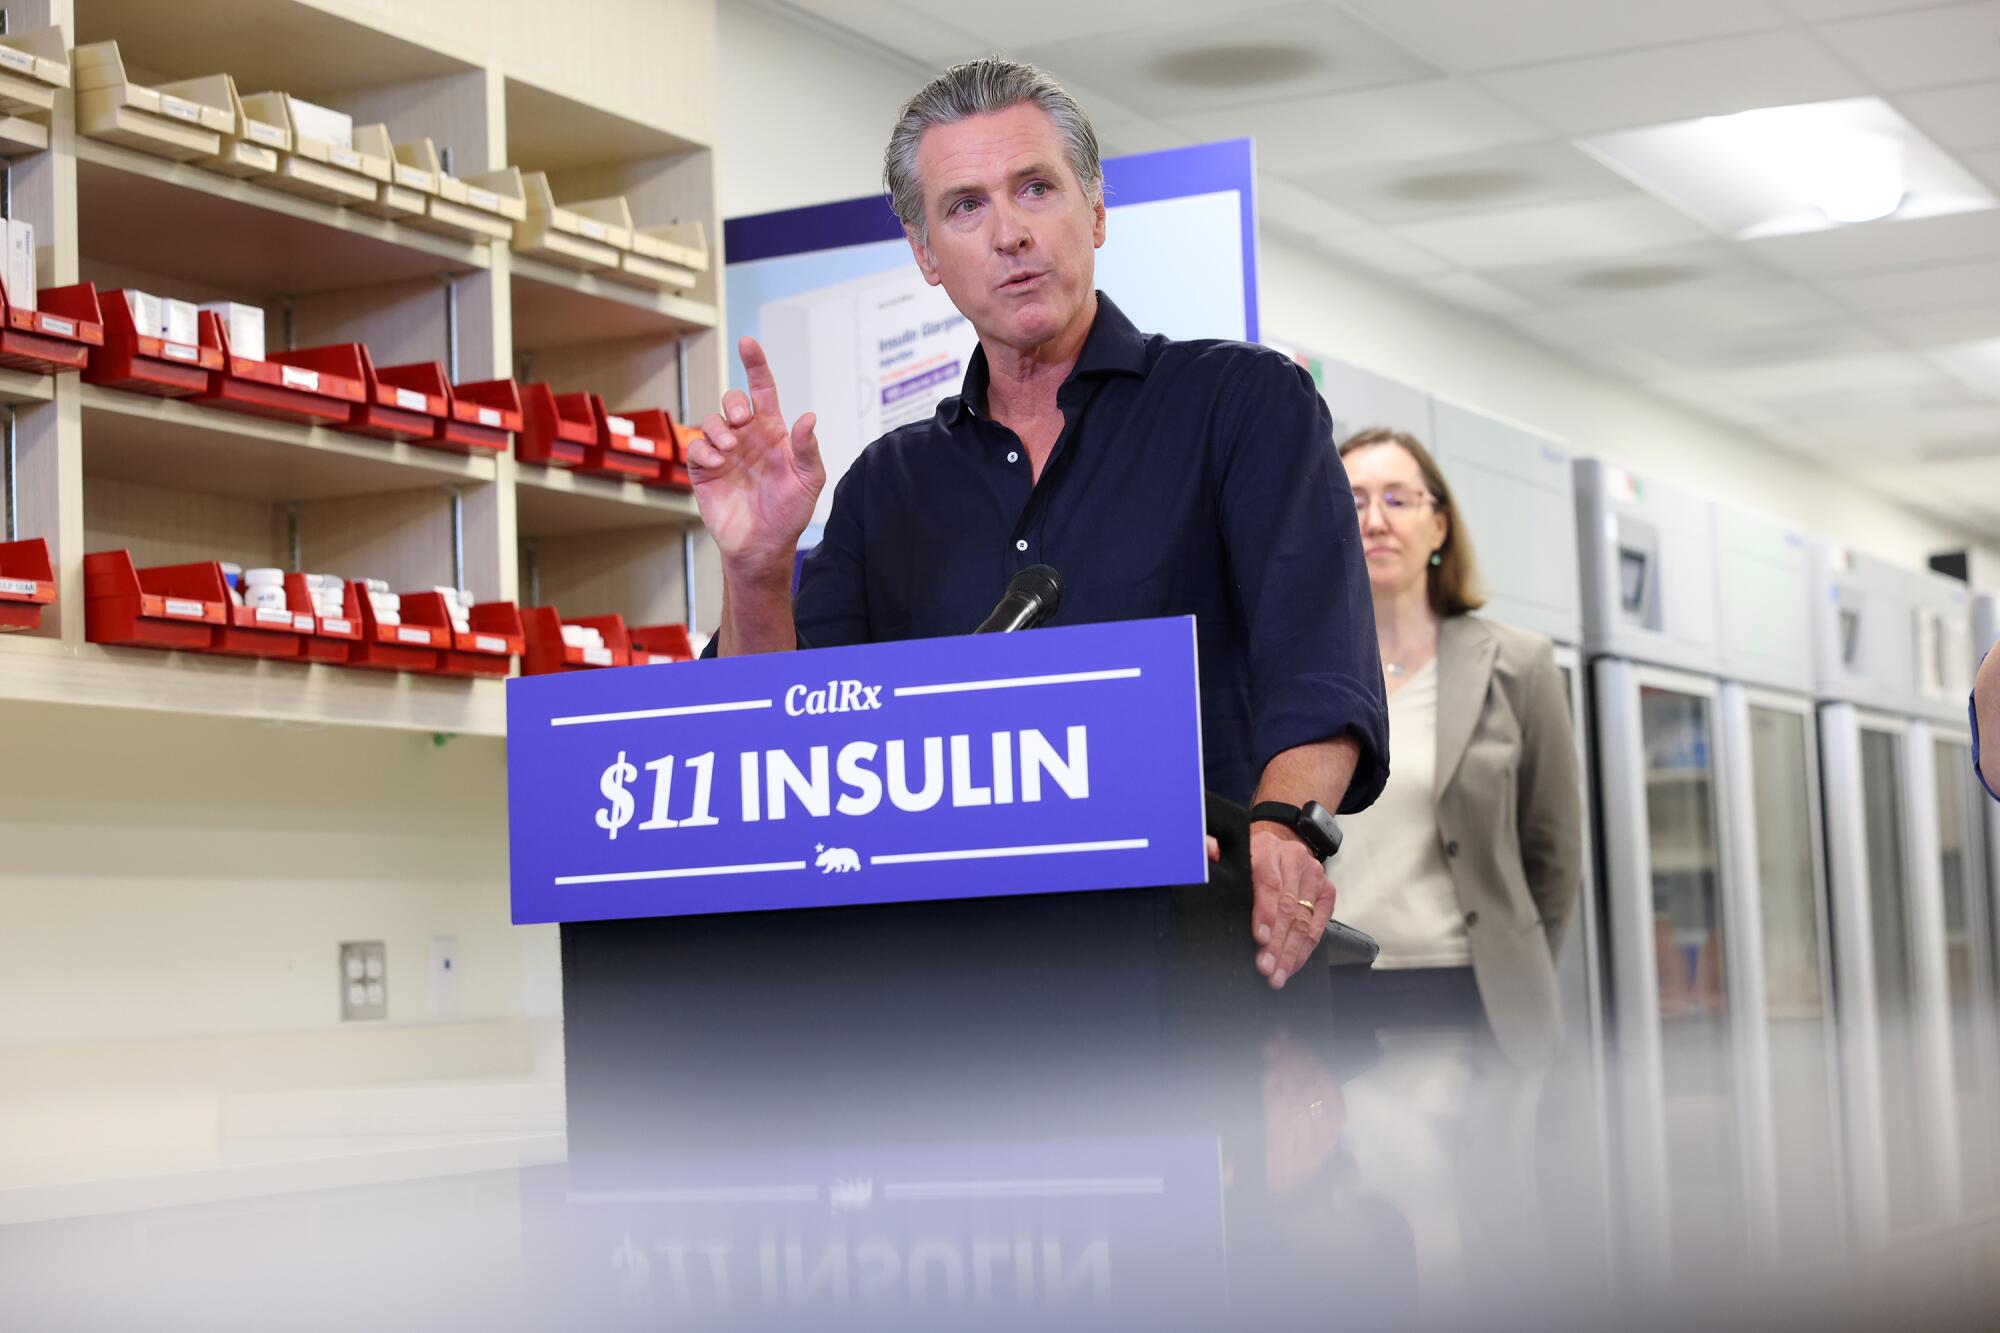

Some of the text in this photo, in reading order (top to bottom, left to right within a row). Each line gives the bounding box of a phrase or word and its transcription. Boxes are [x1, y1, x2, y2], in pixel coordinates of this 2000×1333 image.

[879, 329, 917, 352] Insulin
[784, 679, 883, 717] CalRx
[595, 725, 1090, 840] $11 INSULIN
